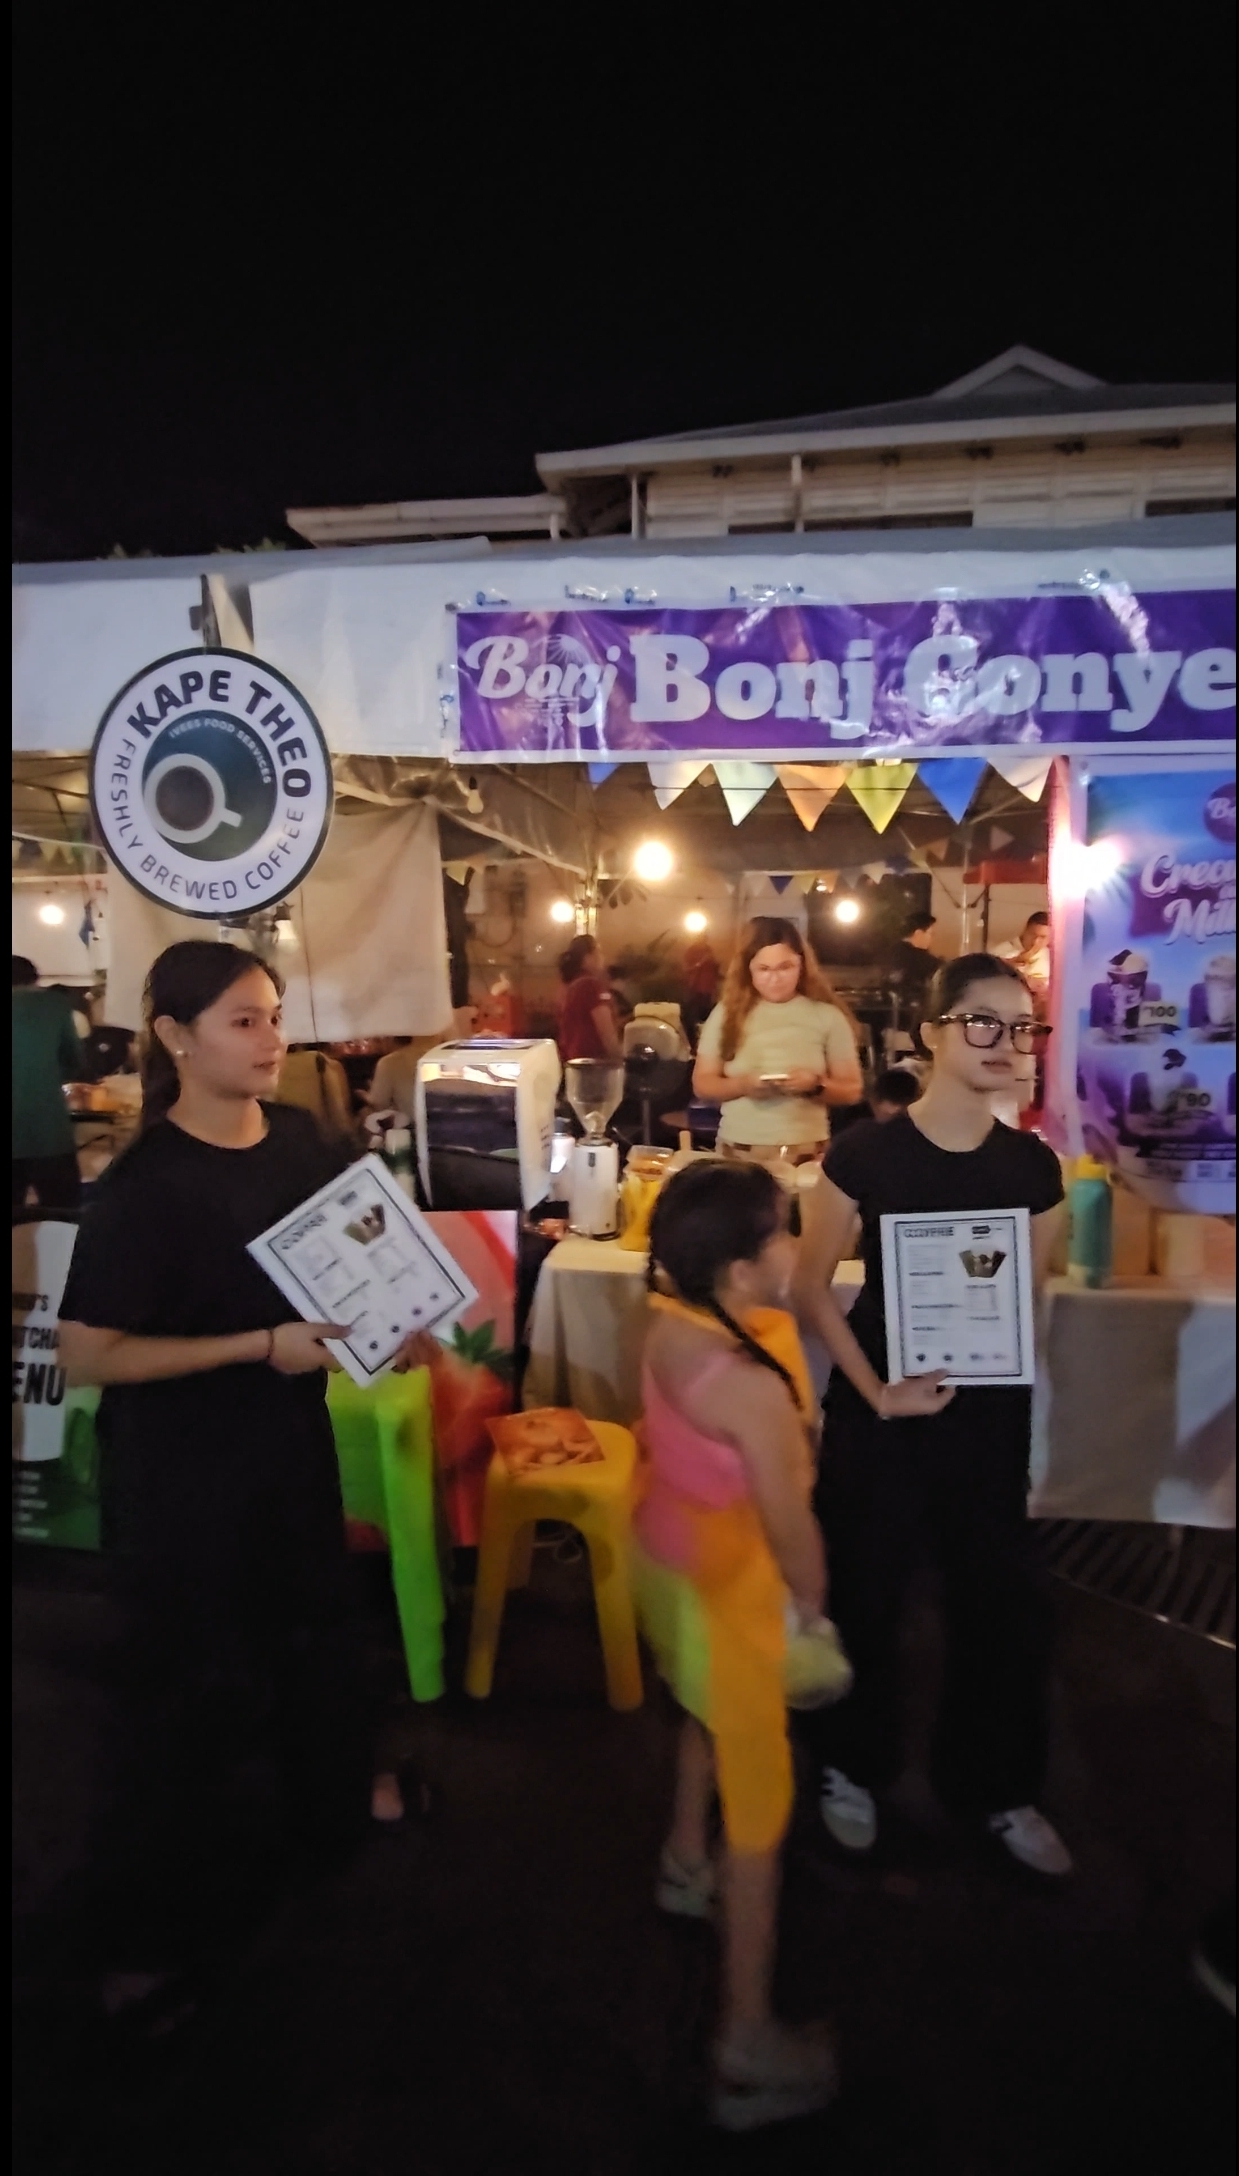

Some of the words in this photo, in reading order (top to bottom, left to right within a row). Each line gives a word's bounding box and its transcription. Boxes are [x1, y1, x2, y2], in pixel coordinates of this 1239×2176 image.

[126, 669, 232, 739] KAPE
[244, 680, 312, 798] THEO
[463, 634, 622, 728] Bonj
[628, 633, 874, 740] Bonj
[203, 717, 236, 734] FOOD
[235, 729, 272, 785] SERVICES
[110, 738, 144, 850] FRESHLY
[139, 854, 238, 901] BREWED
[244, 807, 305, 890] COFFEE
